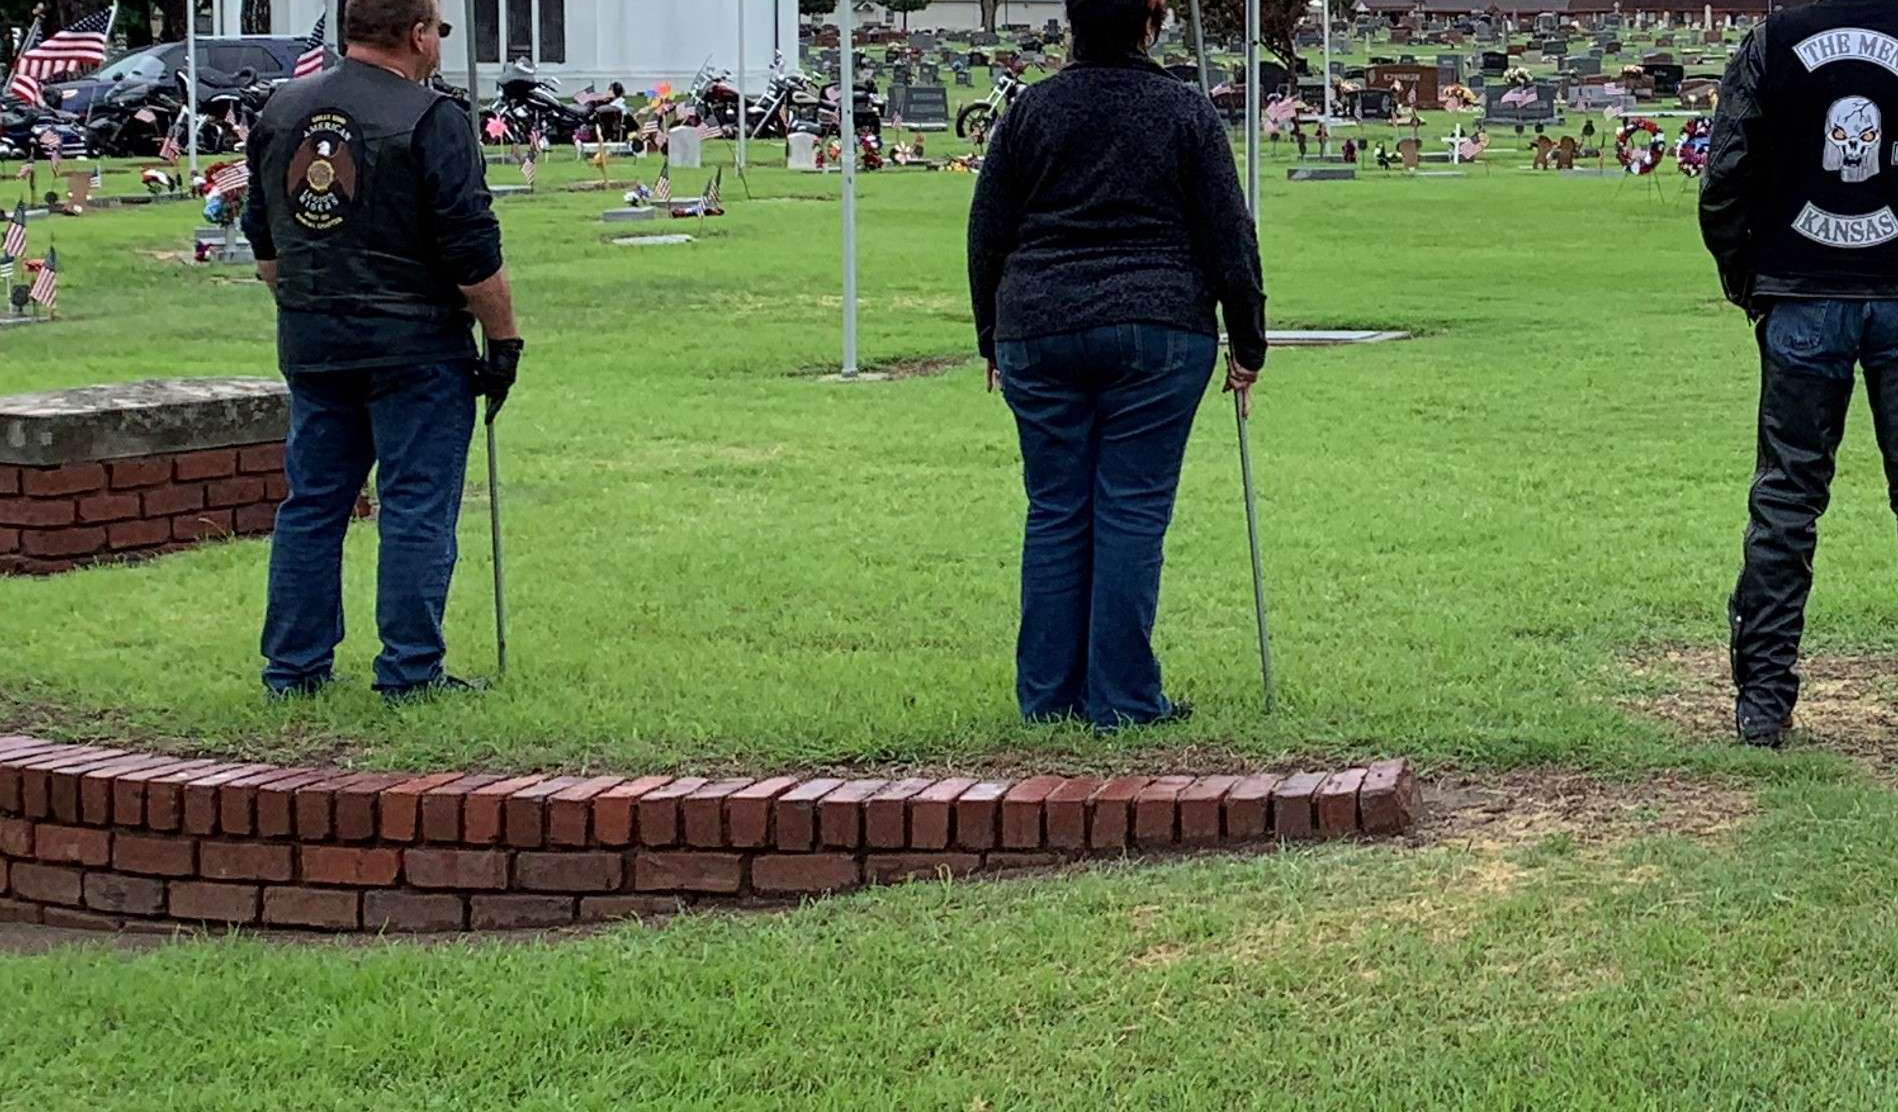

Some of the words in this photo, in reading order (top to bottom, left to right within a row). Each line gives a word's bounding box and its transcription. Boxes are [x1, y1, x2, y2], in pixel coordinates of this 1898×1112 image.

[1803, 33, 1850, 63] THE
[303, 122, 351, 141] AMERICAN
[1800, 210, 1894, 243] KANSAS
